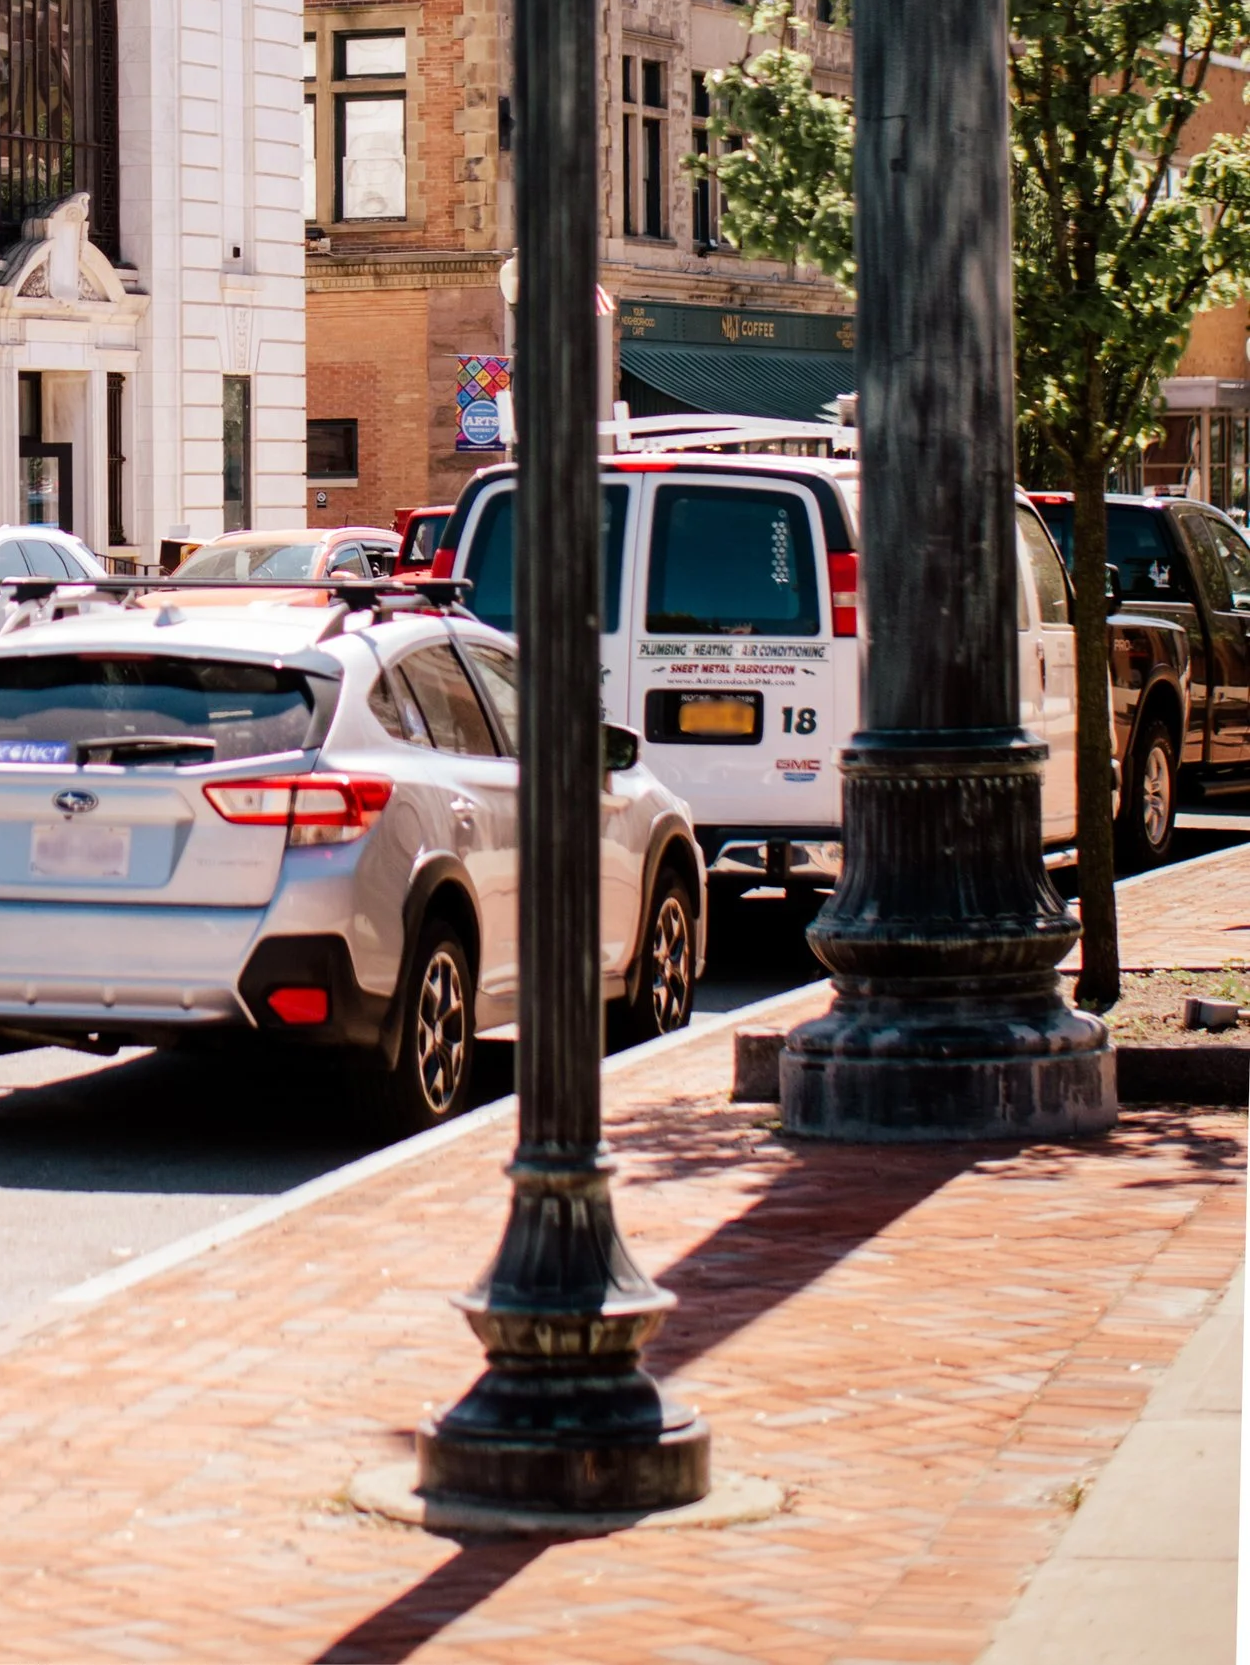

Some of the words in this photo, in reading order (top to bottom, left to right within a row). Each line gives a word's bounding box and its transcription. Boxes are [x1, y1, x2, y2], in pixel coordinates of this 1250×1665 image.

[742, 320, 774, 337] COFFEE
[464, 416, 499, 426] ARTS
[639, 643, 687, 656] PLUMBING
[694, 643, 733, 656] HEATING
[741, 644, 758, 656] AIR
[759, 644, 825, 658] CONDITIONING
[670, 663, 699, 674] SHEET
[701, 663, 730, 674] METAL
[734, 663, 796, 675] FABRICATION
[782, 706, 816, 735] 18
[776, 759, 821, 771] GMC
